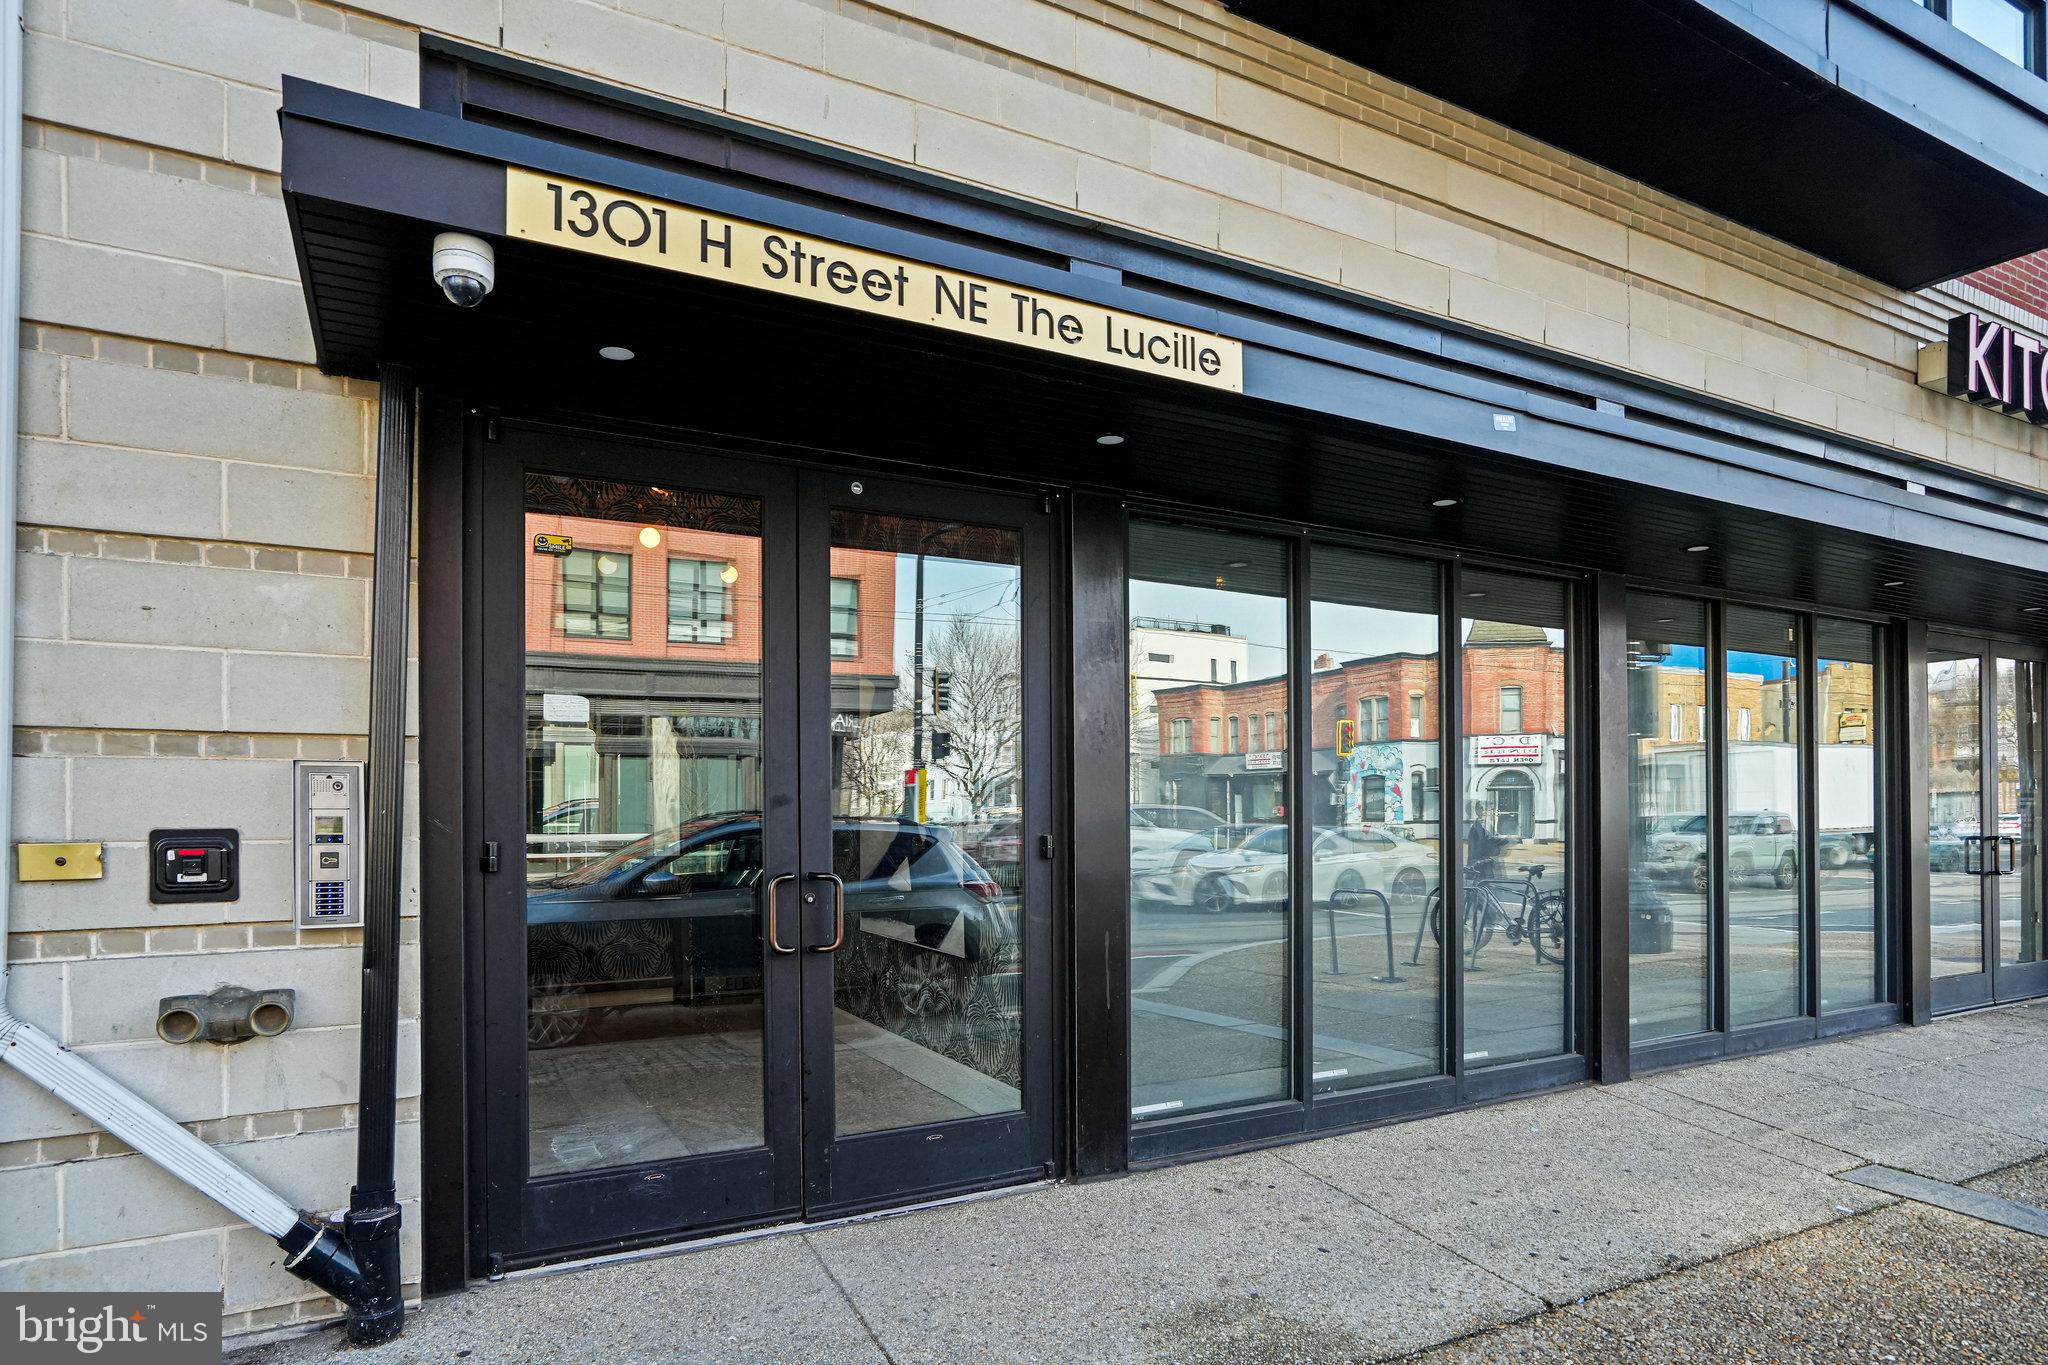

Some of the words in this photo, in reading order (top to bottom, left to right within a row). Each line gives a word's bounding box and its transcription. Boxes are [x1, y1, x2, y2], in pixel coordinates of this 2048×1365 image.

[546, 183, 668, 254] 1301
[700, 219, 732, 268] H
[762, 235, 909, 307] Street
[936, 274, 988, 325] NE
[1011, 293, 1084, 345] The
[1106, 315, 1222, 376] Lucille
